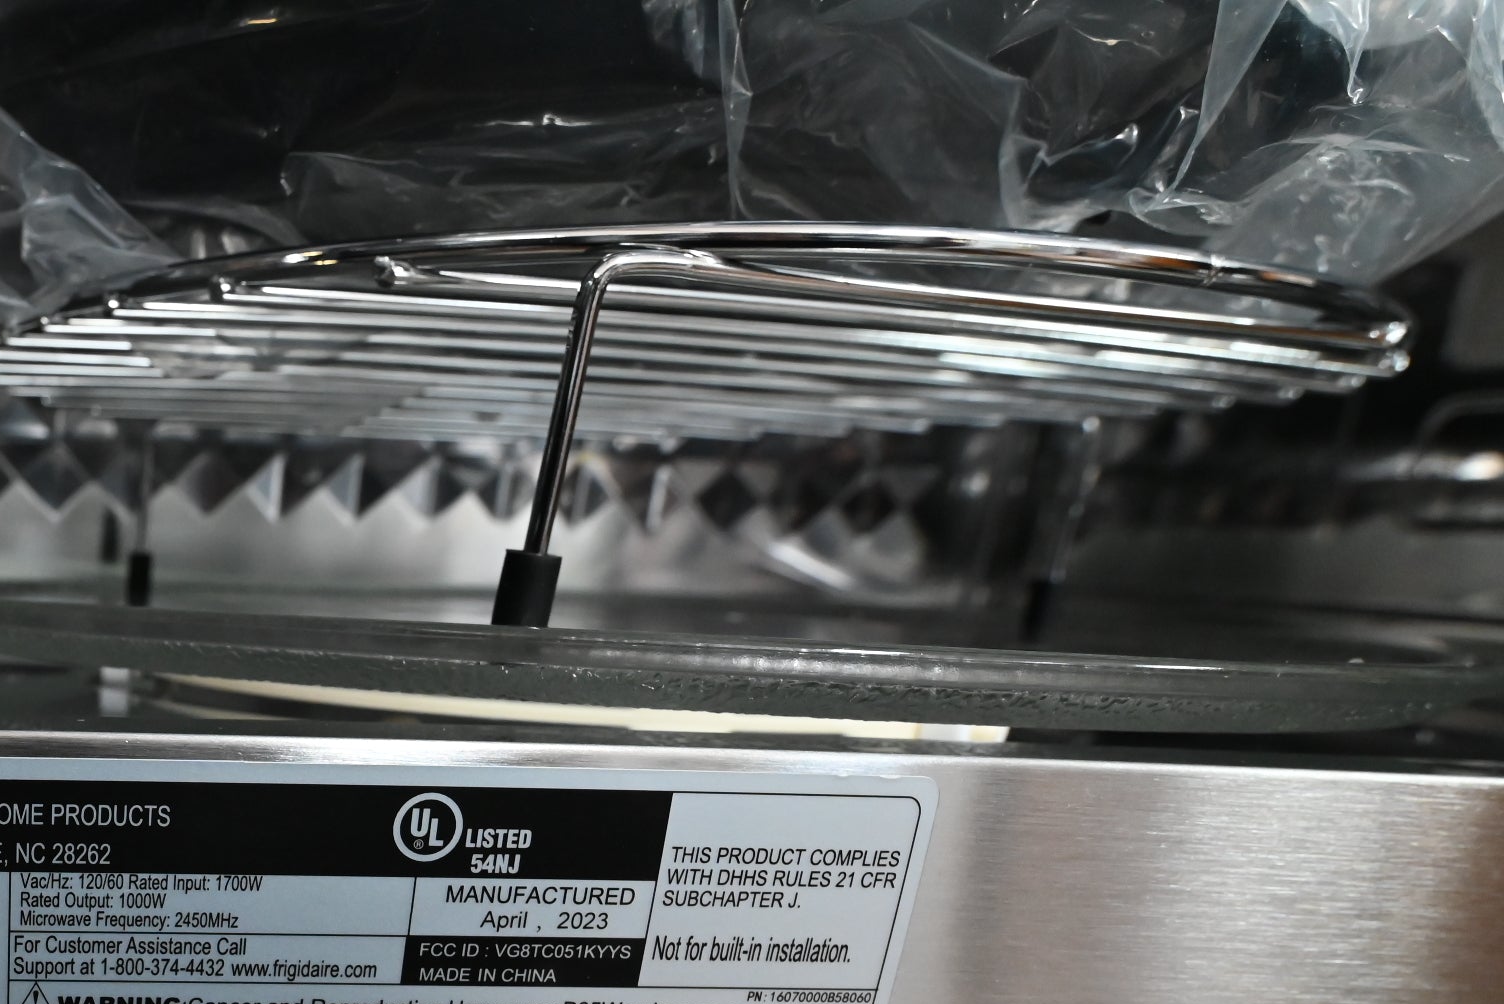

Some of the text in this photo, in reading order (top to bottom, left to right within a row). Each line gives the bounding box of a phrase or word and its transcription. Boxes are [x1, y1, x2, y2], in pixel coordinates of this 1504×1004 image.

[51, 804, 172, 828] PRODUCTS
[465, 828, 532, 849] LISTED
[15, 842, 46, 864] NC
[52, 843, 111, 865] 28262
[470, 854, 521, 874] 54NJ
[672, 846, 901, 868] THIS PRODUCT COMPLIES
[20, 873, 263, 894] Vac/Hz: 120/60 Rated Input: 1700W
[667, 869, 897, 889] WITH DHHS RULES 21 CFR
[20, 892, 167, 912] Rated Output: 1000W
[445, 885, 636, 906] MANUFACTURED
[662, 890, 801, 909] SUBCHAPTER J.
[20, 911, 239, 931] Microwave Frequency: 2450MHz
[480, 910, 528, 932] April
[556, 912, 609, 930] 2023
[13, 936, 247, 956] For Customer Assistance Call
[419, 943, 456, 957] FCC
[495, 944, 632, 960] VG8TC051KYYS
[651, 935, 851, 964] Not for built-in installation.
[13, 957, 377, 983] Support at 1-800-374-4432 www.frigidaire.com
[419, 968, 557, 983] MADE IN CHINA
